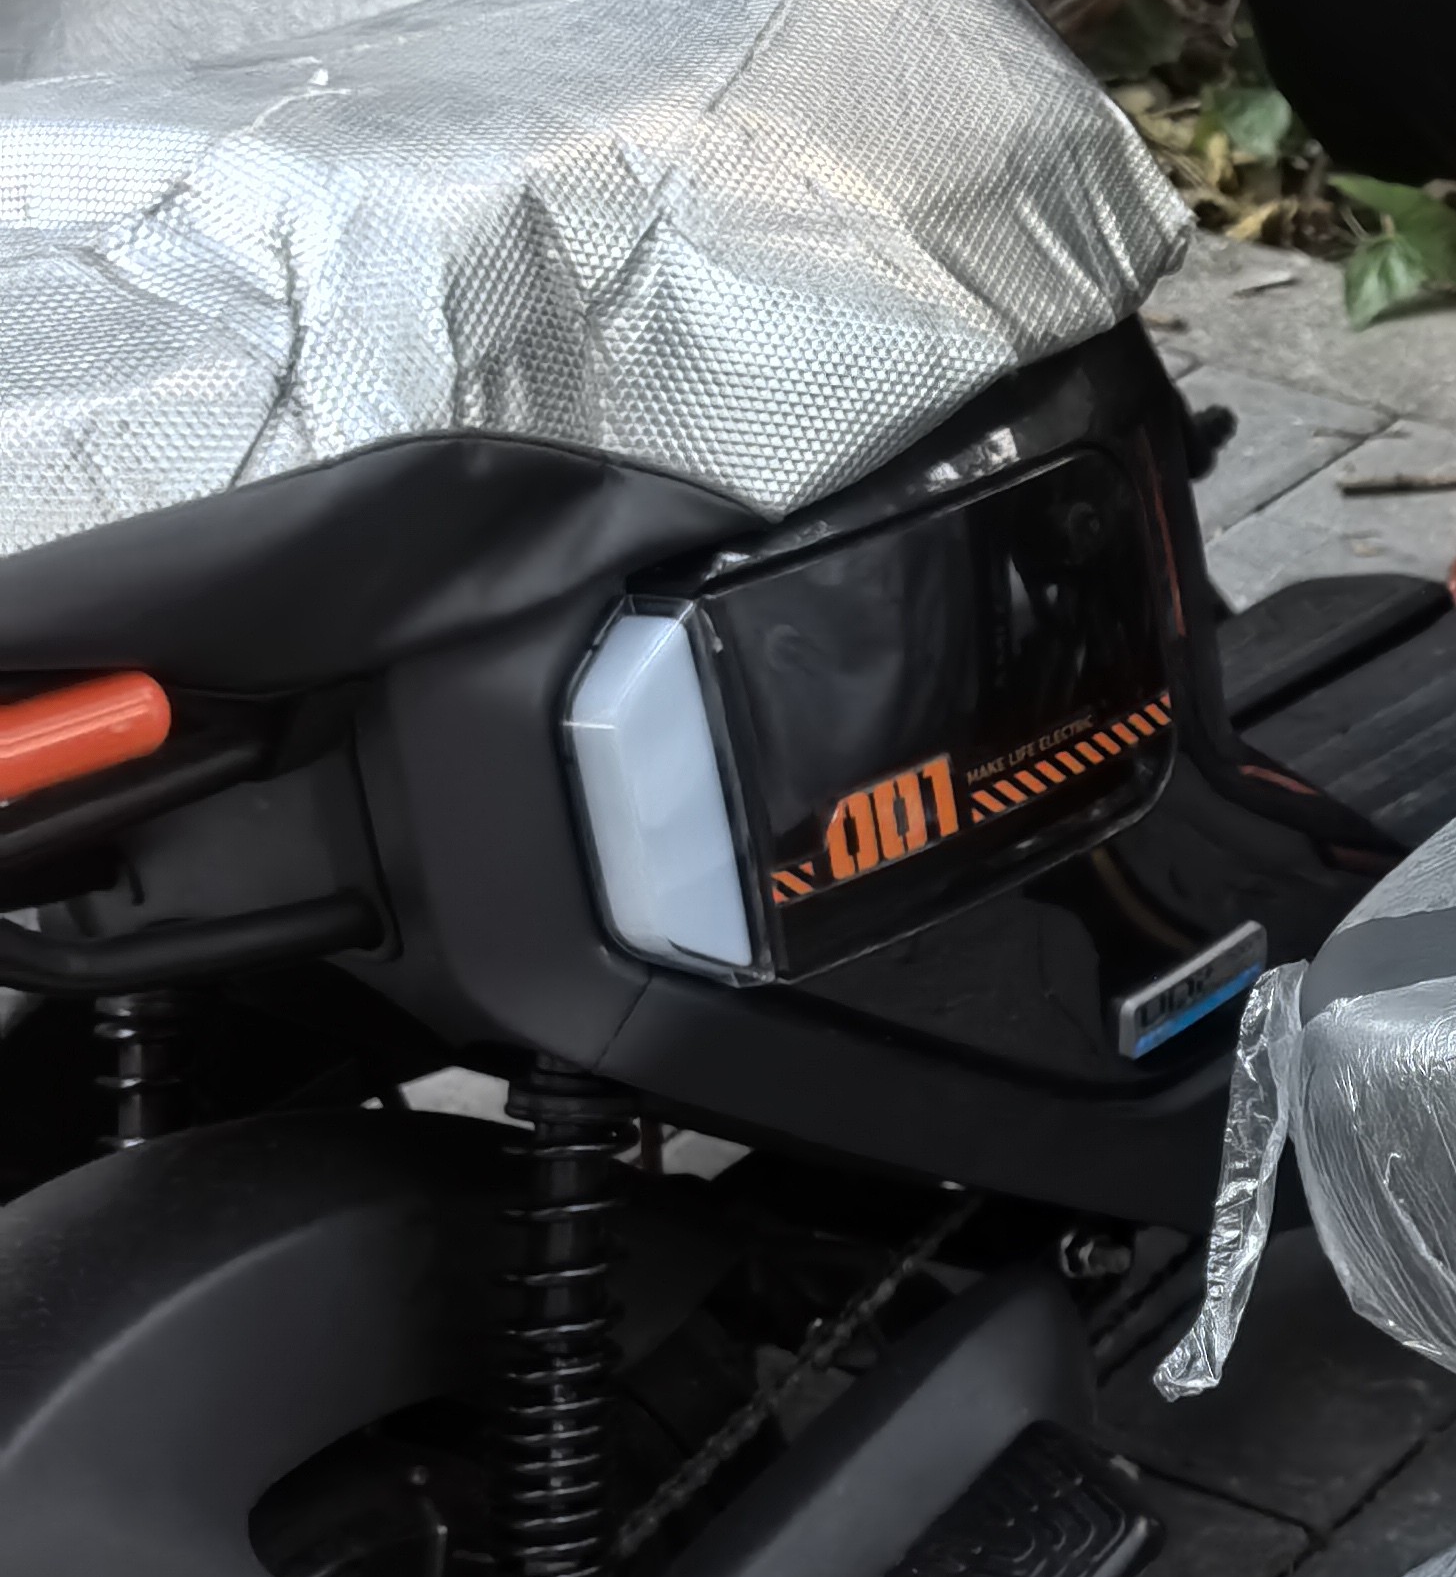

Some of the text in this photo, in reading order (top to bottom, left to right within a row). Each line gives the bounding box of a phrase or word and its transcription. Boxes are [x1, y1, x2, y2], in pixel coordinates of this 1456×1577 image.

[967, 756, 1005, 785] MAKE
[1008, 742, 1036, 770] LIFE
[826, 755, 959, 880] 001
